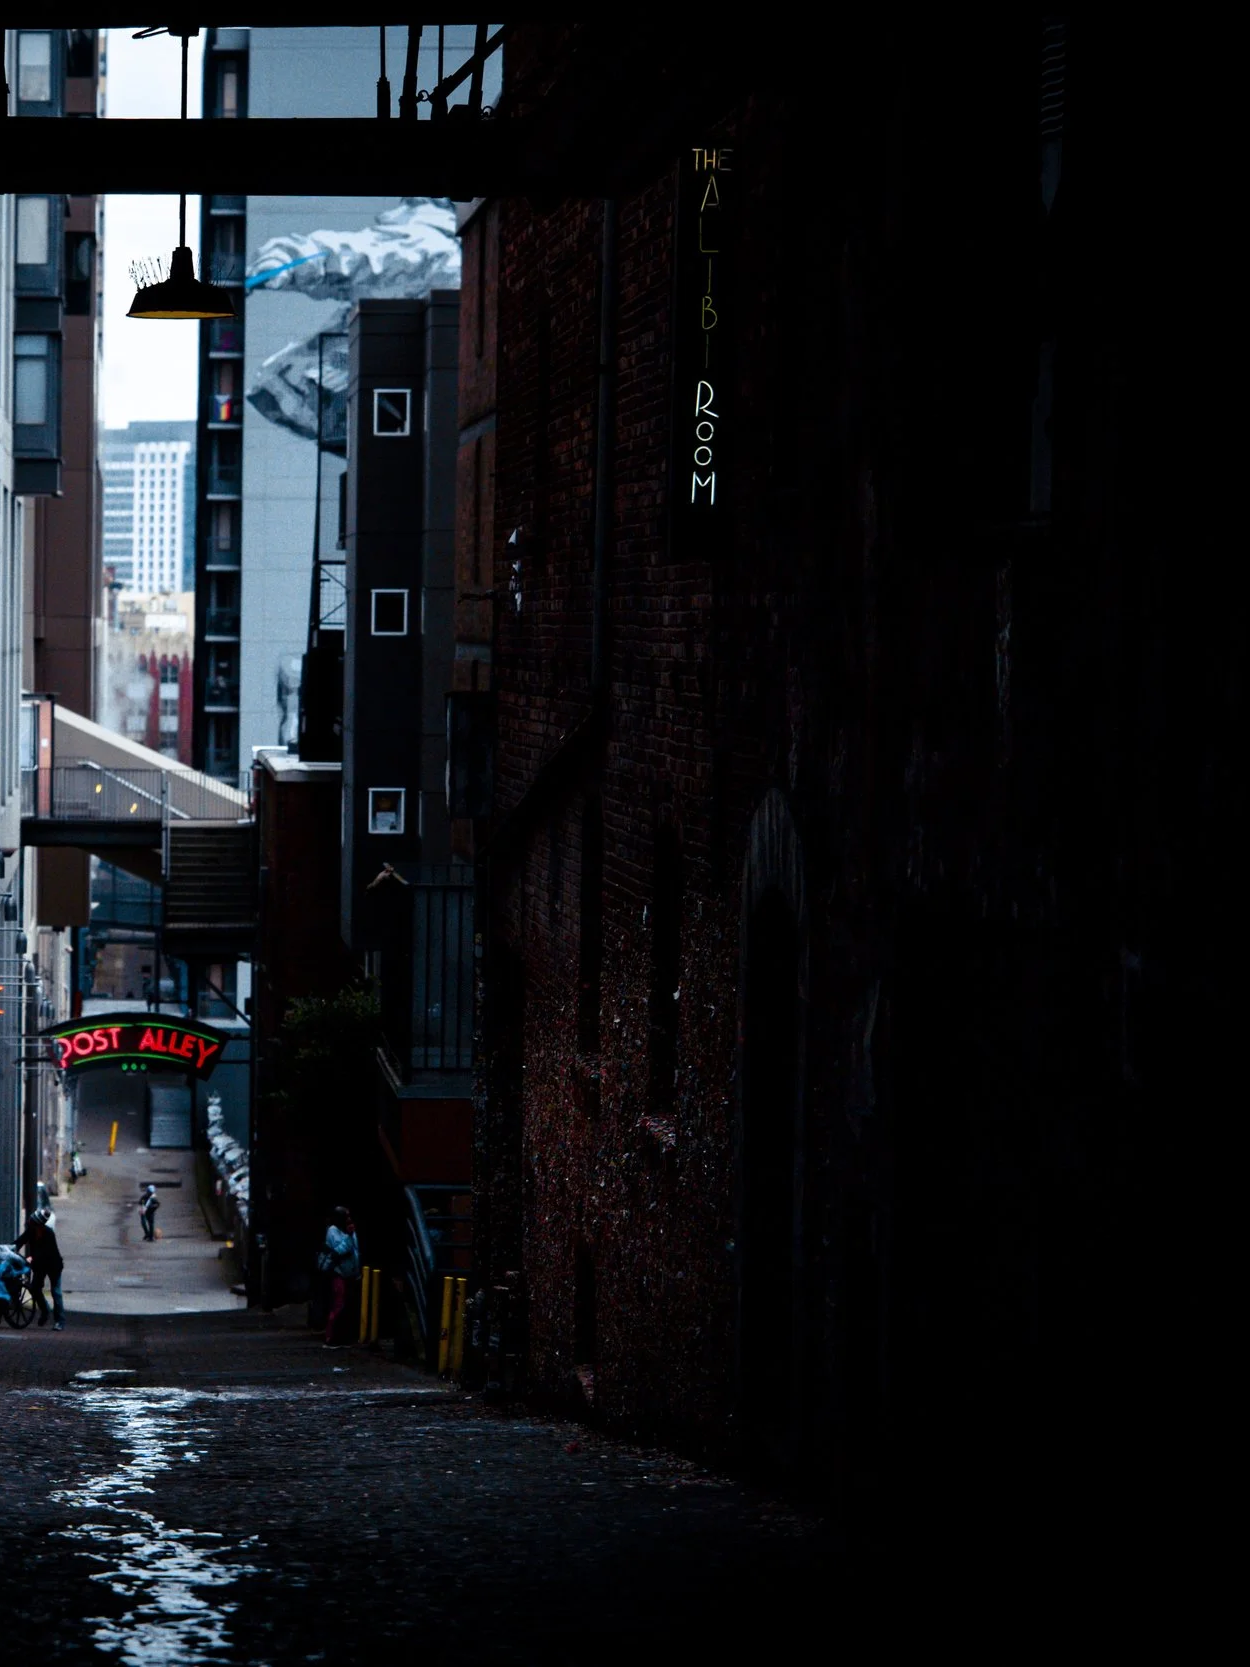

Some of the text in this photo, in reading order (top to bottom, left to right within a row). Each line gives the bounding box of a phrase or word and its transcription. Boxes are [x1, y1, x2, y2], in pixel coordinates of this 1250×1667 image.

[692, 148, 733, 171] THE
[692, 174, 719, 505] ALIBI ROOM
[57, 1027, 219, 1069] POST ALLEY
